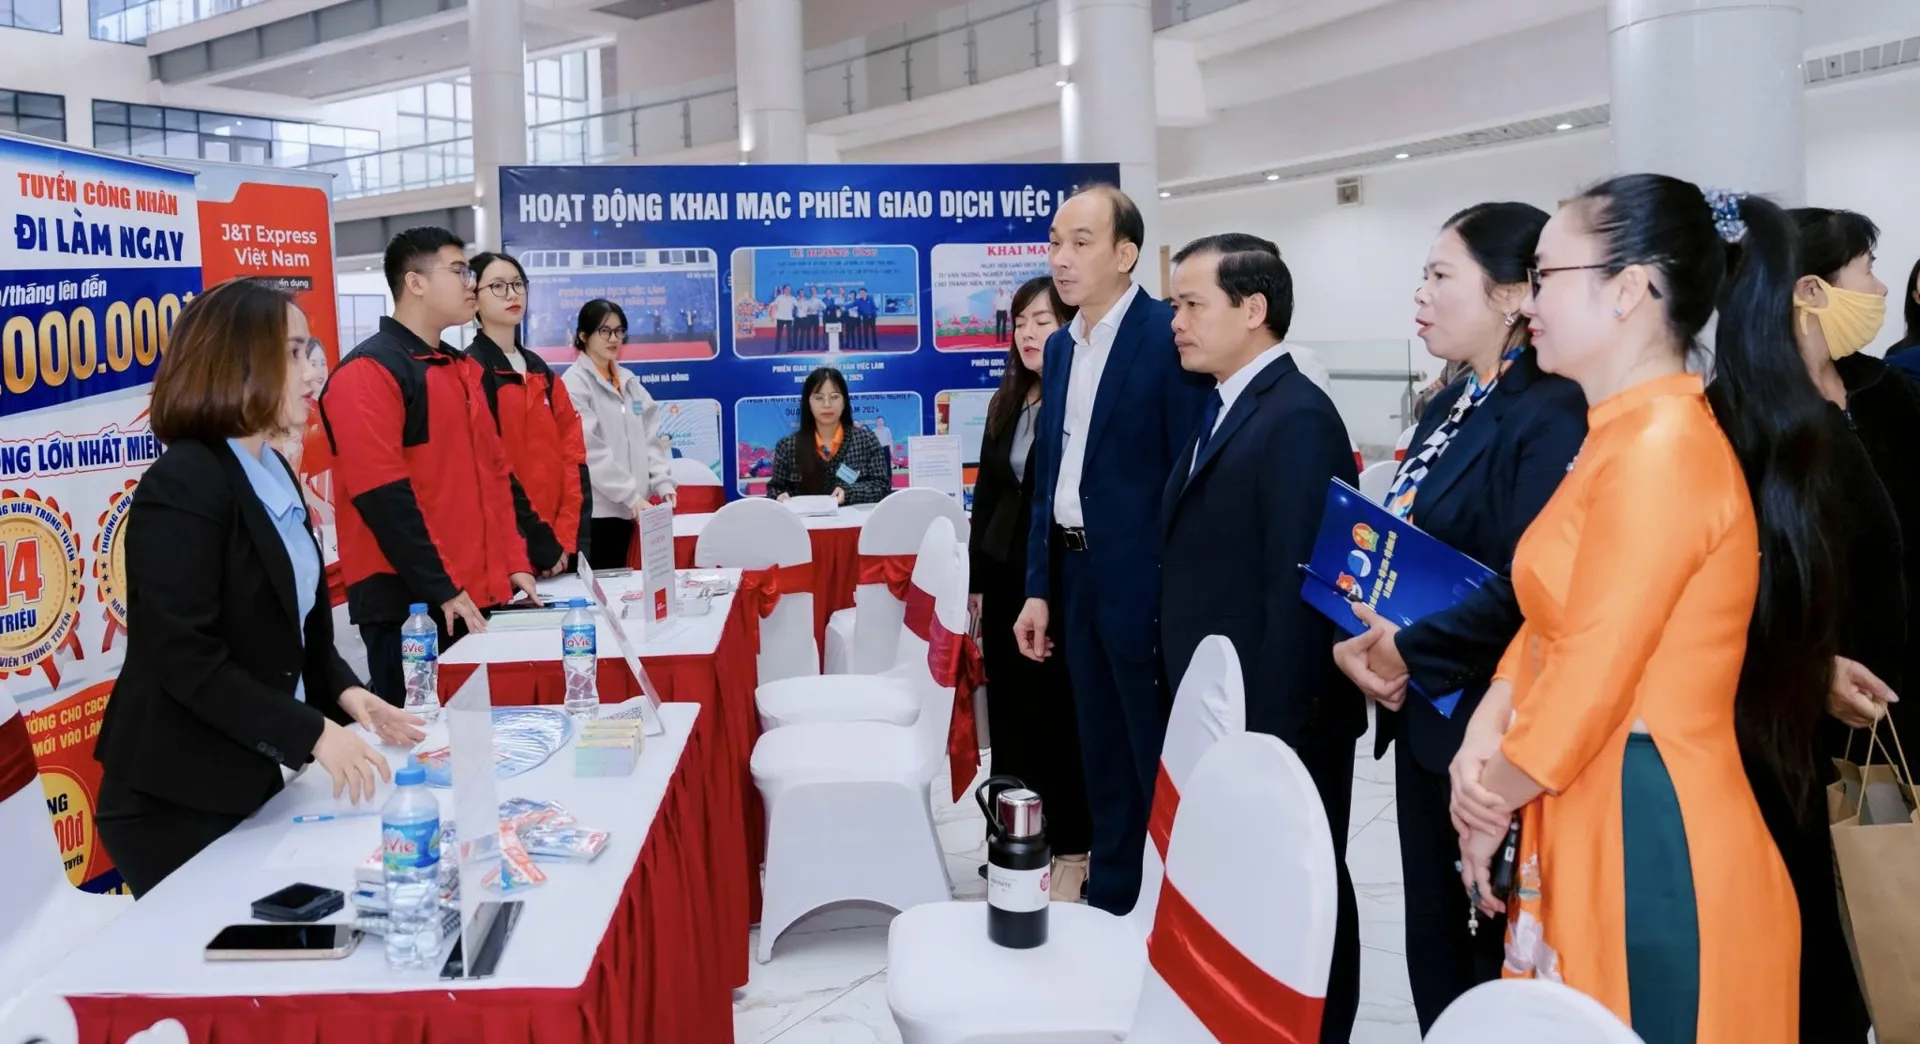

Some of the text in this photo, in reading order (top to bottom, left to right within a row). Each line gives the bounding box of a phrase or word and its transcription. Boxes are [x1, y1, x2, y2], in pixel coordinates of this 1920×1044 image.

[18, 169, 178, 216] TUYỂN CÔNG NHÂN
[519, 193, 586, 229] HOẠT
[592, 187, 663, 229] ĐỘNG
[669, 192, 728, 221] KHAI
[736, 190, 792, 226] MẠC
[799, 185, 872, 220] PHIÊN
[878, 189, 933, 219] GIAO
[940, 189, 994, 223] DỊCH
[1000, 184, 1051, 223] VIỆC
[14, 207, 184, 262] ĐI LÀM NGAY
[222, 224, 317, 247] J&T Express
[235, 248, 309, 272] Việt Nam
[987, 245, 1050, 258] KHAI MẠ
[0, 274, 107, 307] /tháng lên đến
[0, 446, 31, 475] NG
[38, 437, 74, 471] LỚN
[78, 430, 122, 467] NHẤT
[11, 502, 32, 514] VIÊN
[60, 704, 82, 726] CHO
[60, 726, 82, 749] VÀO
